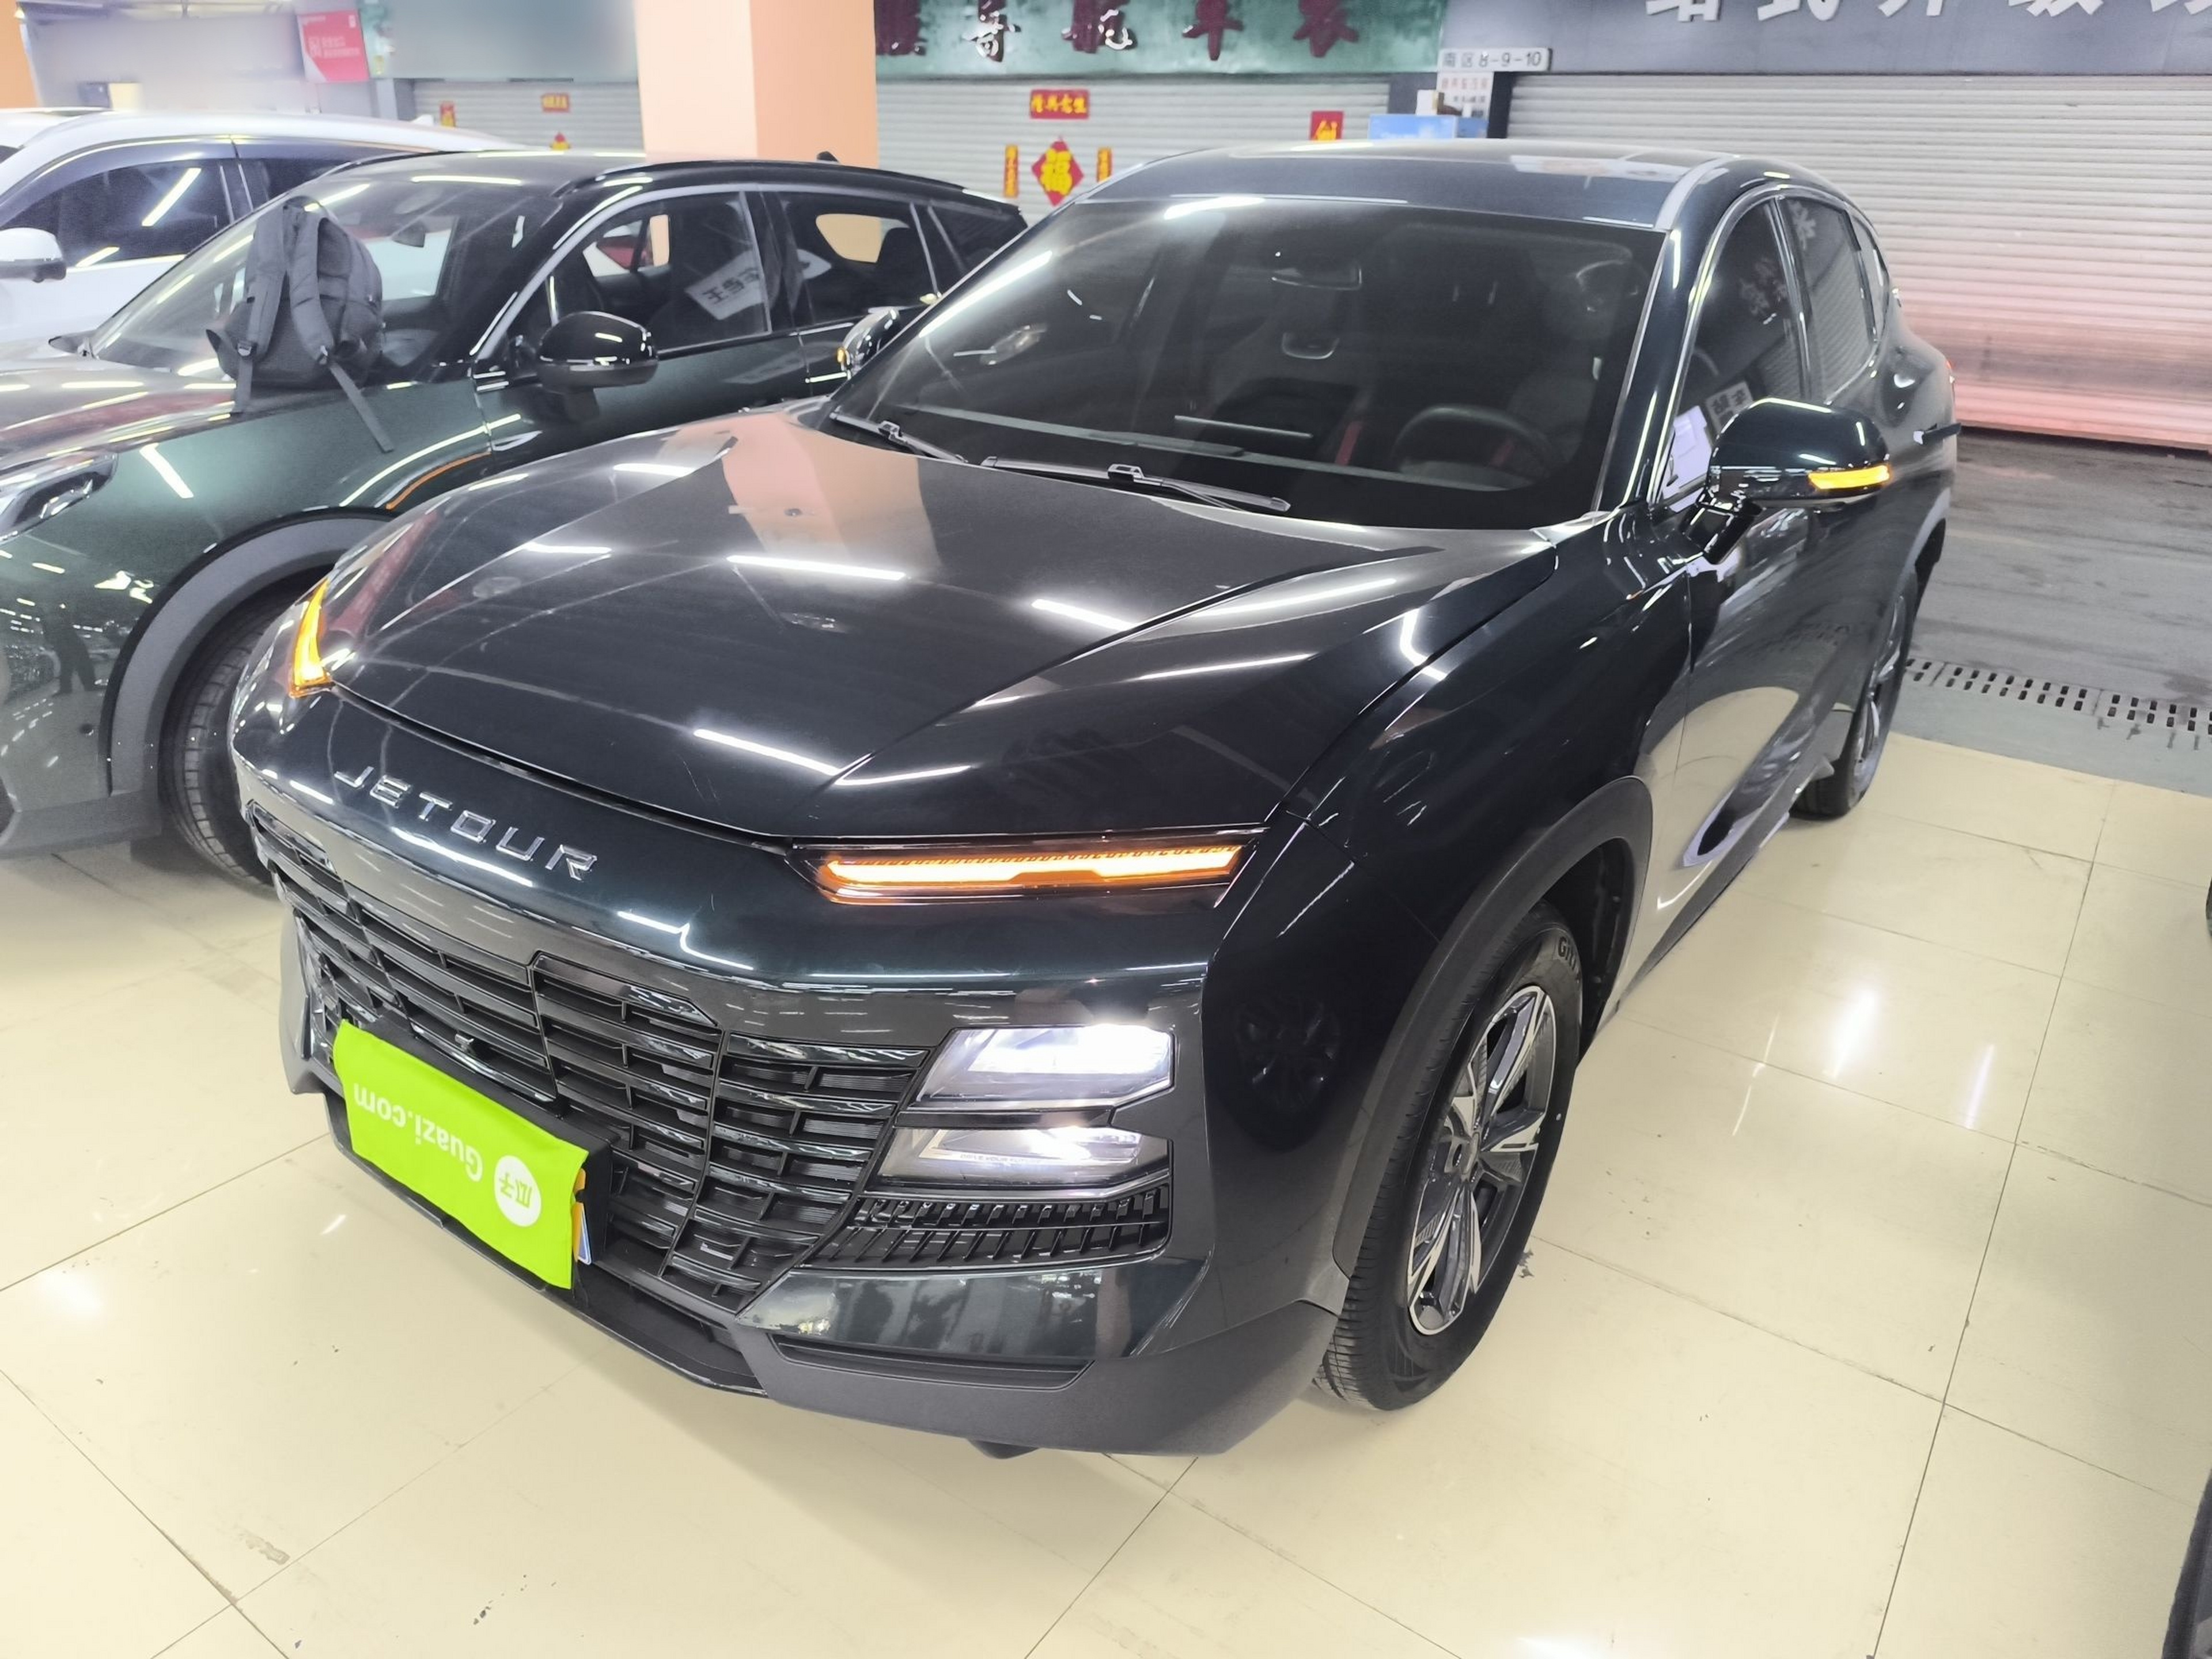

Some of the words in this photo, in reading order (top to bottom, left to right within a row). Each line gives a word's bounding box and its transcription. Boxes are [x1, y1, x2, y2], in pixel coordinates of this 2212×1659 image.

[334, 766, 597, 881] JETOUR
[353, 1083, 483, 1183] Guazi.com
[499, 1172, 533, 1209] 瓜子
